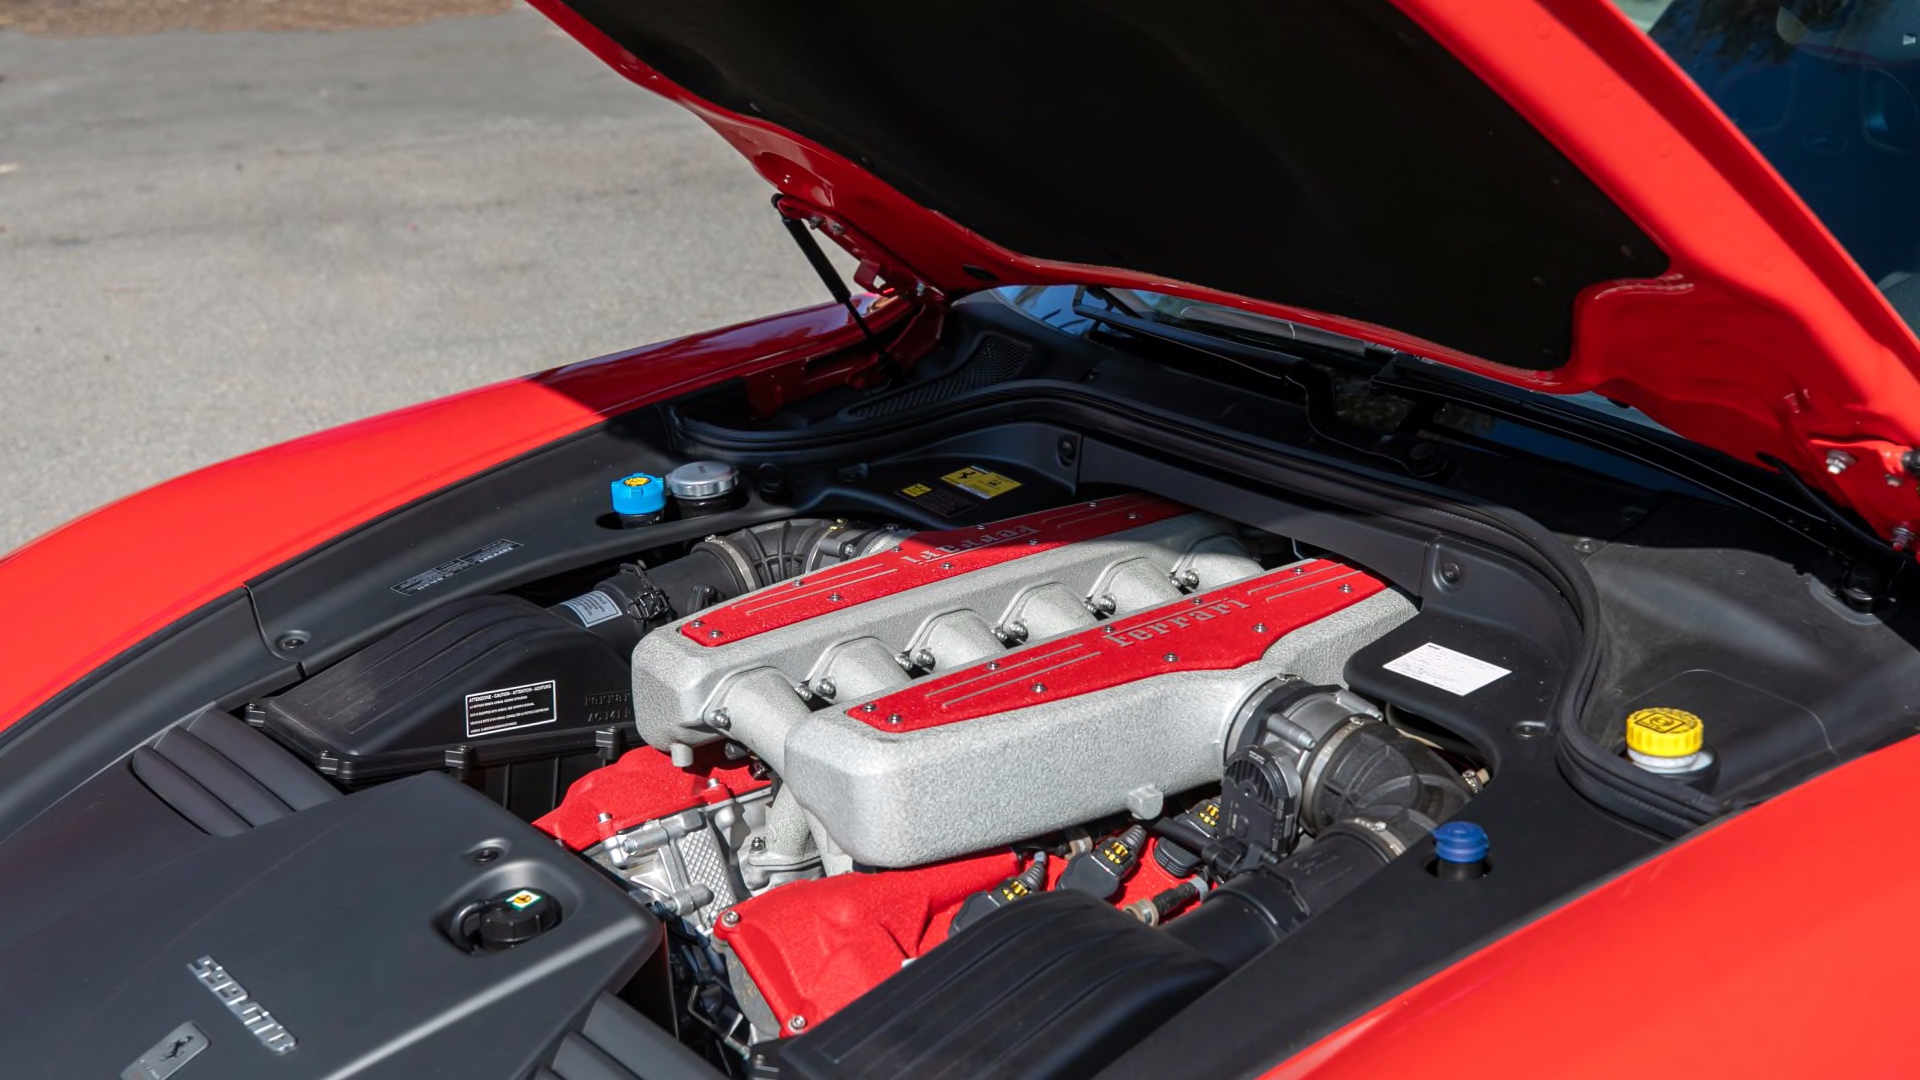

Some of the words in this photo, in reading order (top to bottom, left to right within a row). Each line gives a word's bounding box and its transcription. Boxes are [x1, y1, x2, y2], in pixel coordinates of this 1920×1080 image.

[900, 525, 1040, 565] Ferrari
[1101, 597, 1249, 647] Ferrari
[494, 691, 510, 699] CAUTION
[512, 687, 532, 695] ATTENTION
